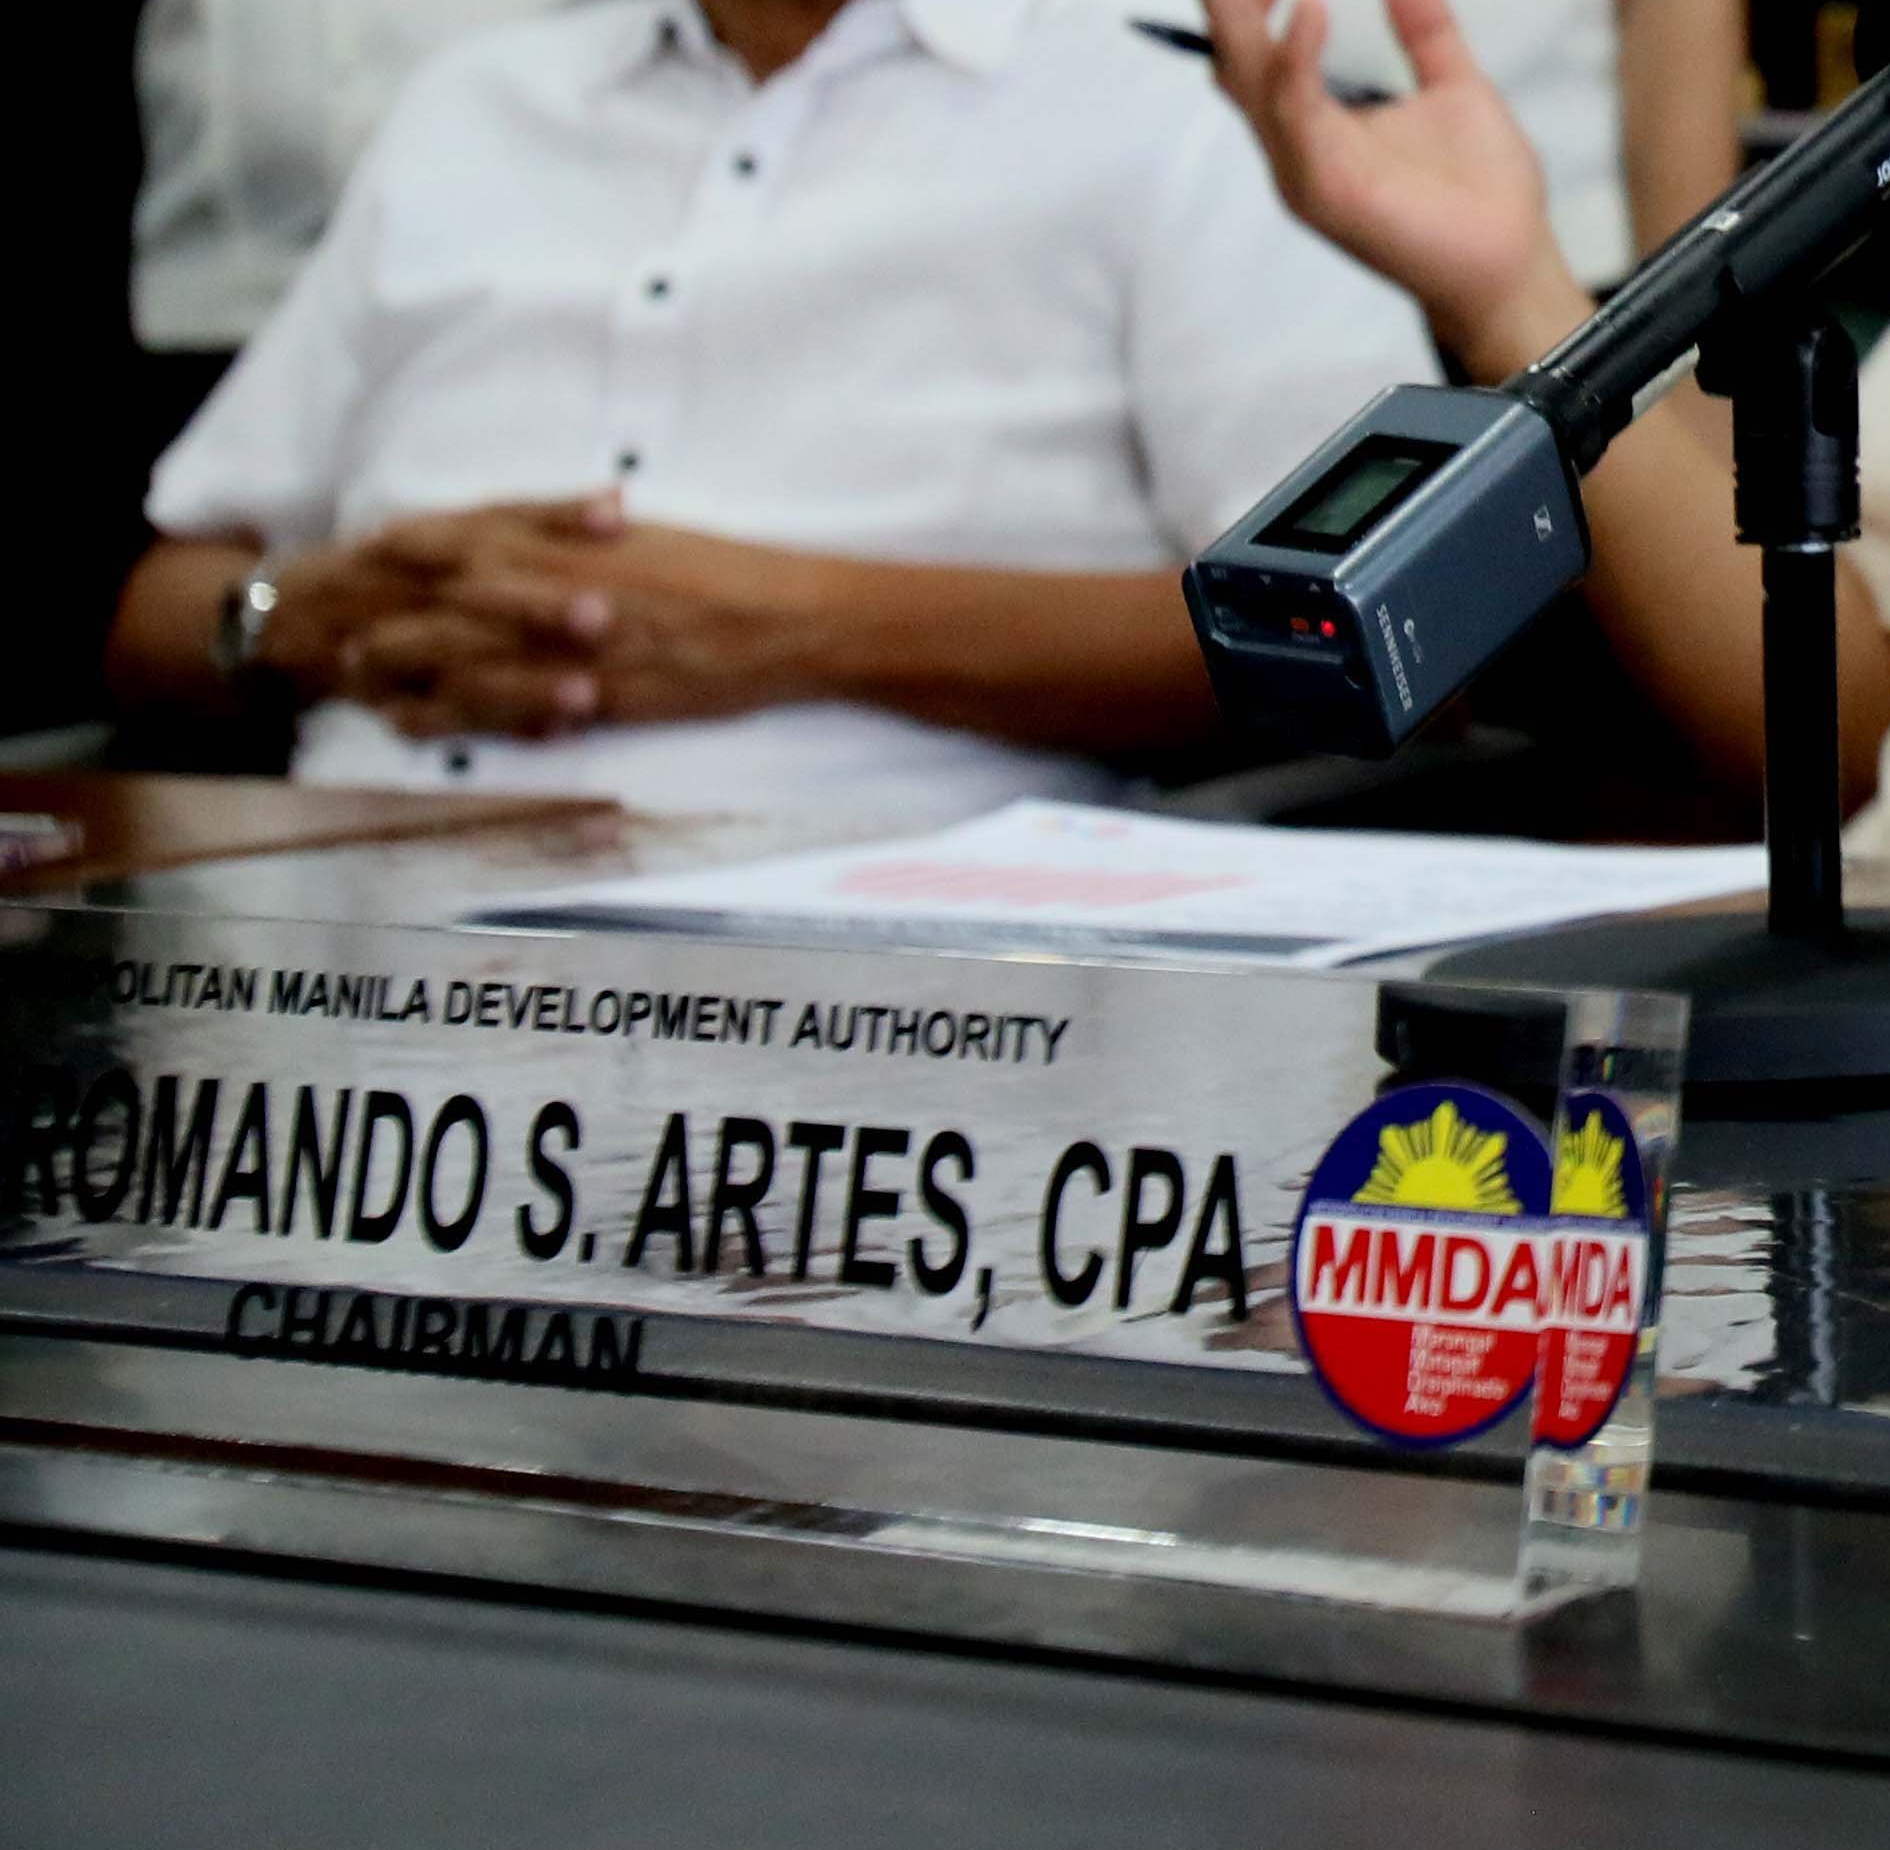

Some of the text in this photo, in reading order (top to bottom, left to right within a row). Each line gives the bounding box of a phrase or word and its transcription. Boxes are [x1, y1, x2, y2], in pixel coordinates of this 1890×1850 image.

[1376, 603, 1413, 712] SENNHEISER
[266, 969, 430, 1025] MANILA
[443, 980, 785, 1048] DEVELOPMENT
[790, 1001, 1074, 1065] AUTHORITY
[515, 1101, 595, 1264] S.
[621, 1111, 994, 1333] ARTES,
[1040, 1140, 1252, 1323] CPA
[1307, 1224, 1549, 1320] MMDA
[228, 1282, 646, 1374] CHAIRMAN
